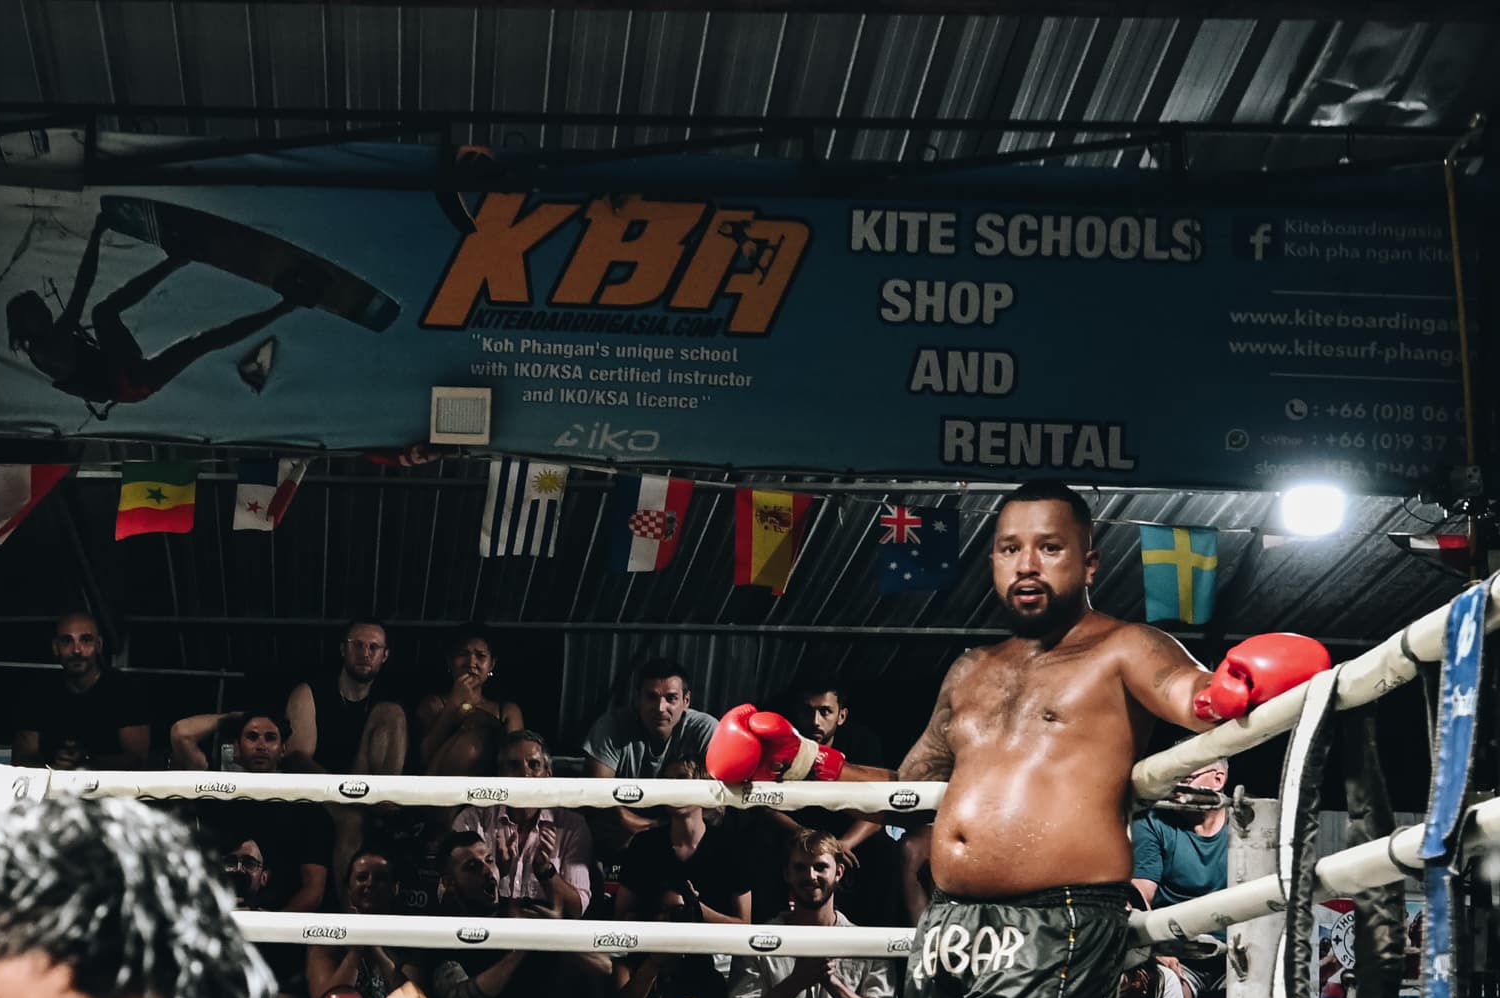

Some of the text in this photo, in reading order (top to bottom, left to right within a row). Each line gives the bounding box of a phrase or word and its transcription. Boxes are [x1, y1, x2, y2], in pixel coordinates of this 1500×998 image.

[850, 208, 1204, 264] KITE SCHOOLS
[1283, 241, 1320, 257] Koh
[1326, 244, 1361, 262] pha
[1367, 248, 1412, 264] ngan
[880, 278, 1015, 326] SHOP
[470, 308, 725, 336] KITEBOARDINGASIA.COM
[520, 338, 609, 359] Phangan's
[616, 341, 675, 364] unique
[680, 345, 739, 363] school
[470, 361, 754, 388] with IKO/KSA certified instructor
[908, 348, 1015, 396] AND
[522, 388, 553, 404] and
[560, 388, 628, 406] IKO/KSA
[1325, 402, 1367, 419] +66
[1372, 402, 1415, 423] (0)8
[942, 419, 1136, 471] RENTAL
[1326, 432, 1366, 449] +66
